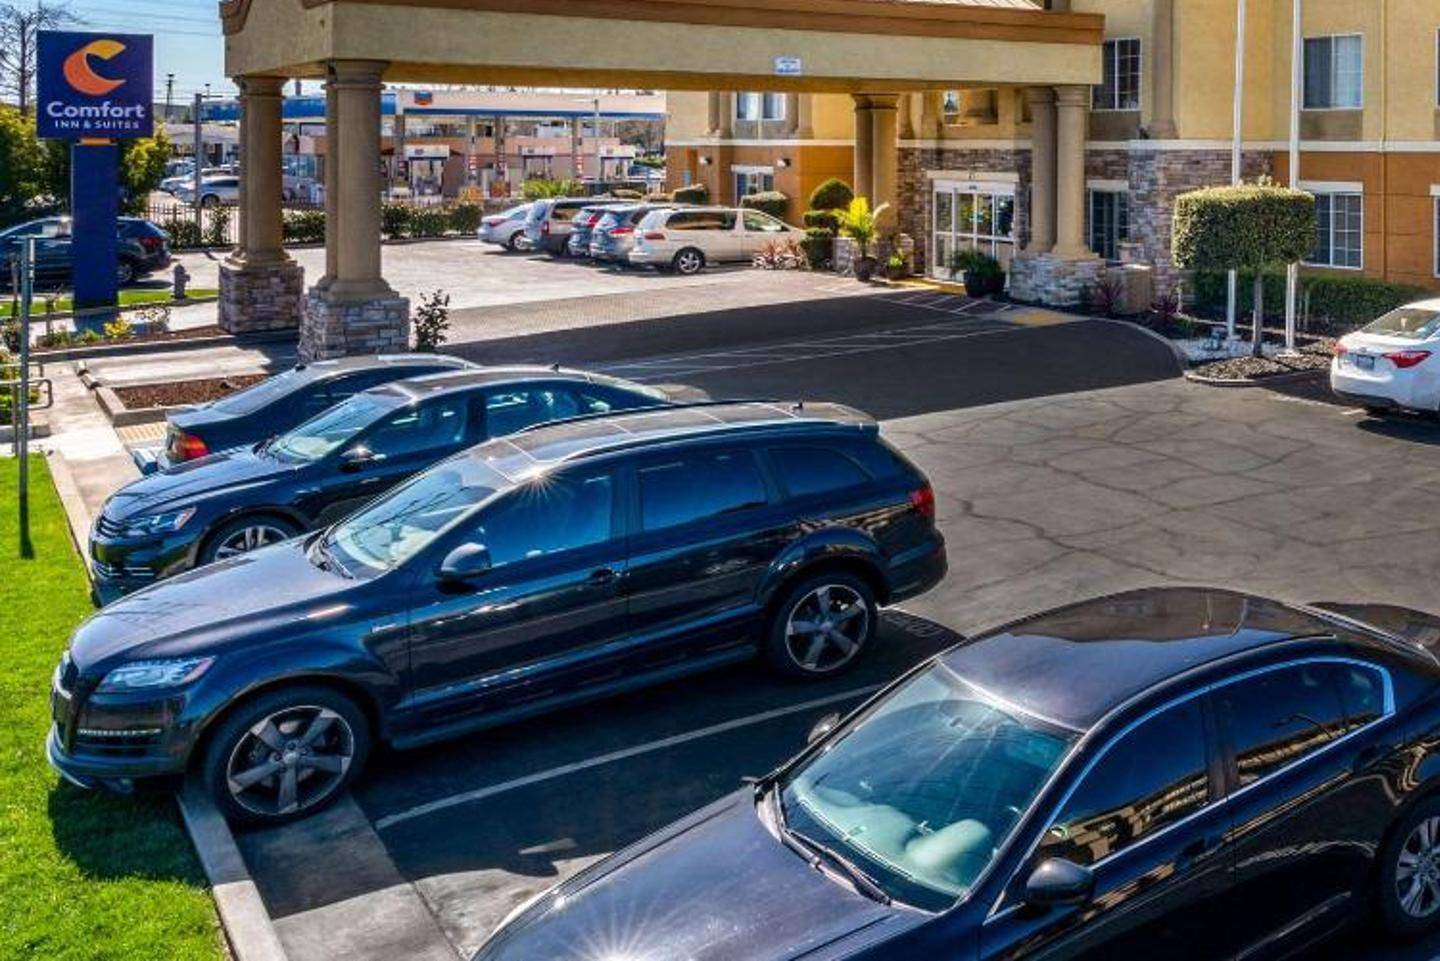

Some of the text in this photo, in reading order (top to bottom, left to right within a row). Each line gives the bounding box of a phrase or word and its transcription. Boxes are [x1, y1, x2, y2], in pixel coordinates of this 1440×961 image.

[46, 100, 145, 118] Comfort
[54, 120, 140, 129] INN & SUITES
